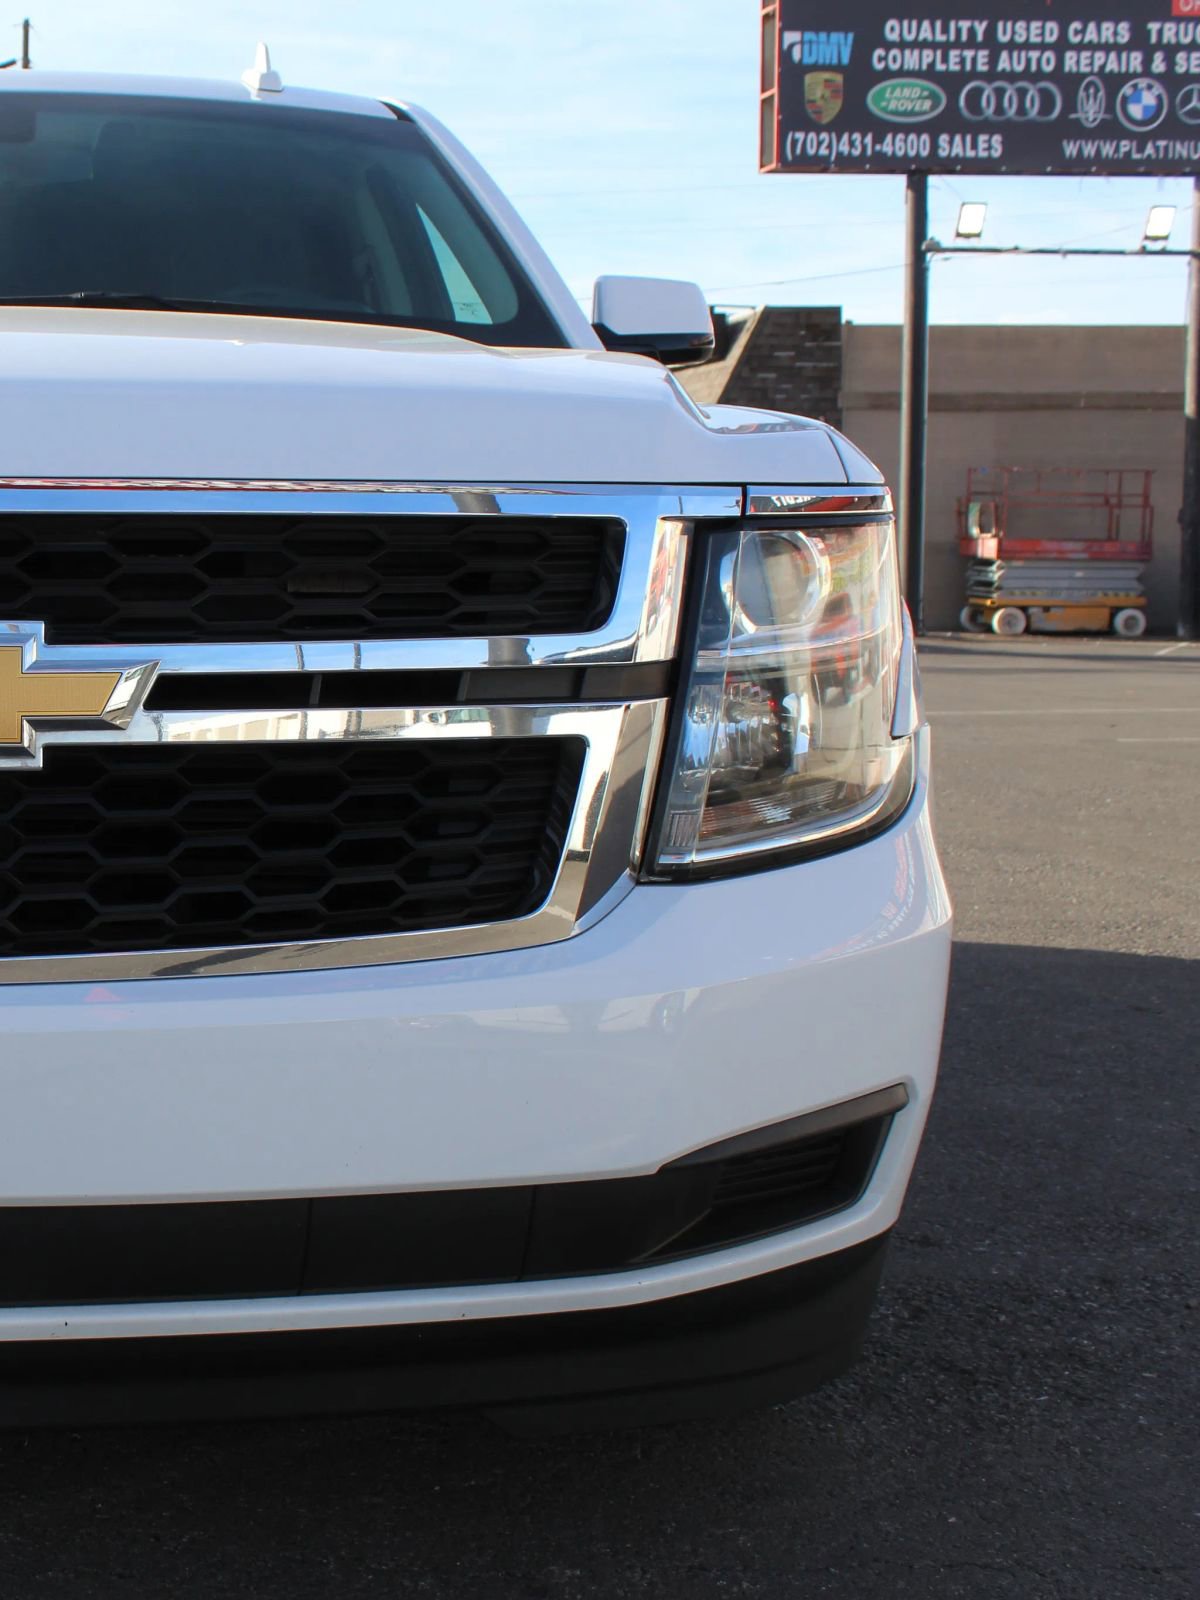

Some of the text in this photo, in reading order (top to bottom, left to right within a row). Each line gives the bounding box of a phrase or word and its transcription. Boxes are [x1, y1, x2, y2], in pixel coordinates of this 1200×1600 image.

[884, 18, 989, 43] QUALITY
[996, 20, 1060, 44] USED
[1067, 20, 1131, 45] CARS
[872, 47, 990, 72] COMPLETE
[996, 49, 1057, 73] AUTO
[1063, 50, 1144, 74] REPAIR
[1150, 50, 1167, 74] &
[785, 130, 1003, 161] (702)431-4600 SALES
